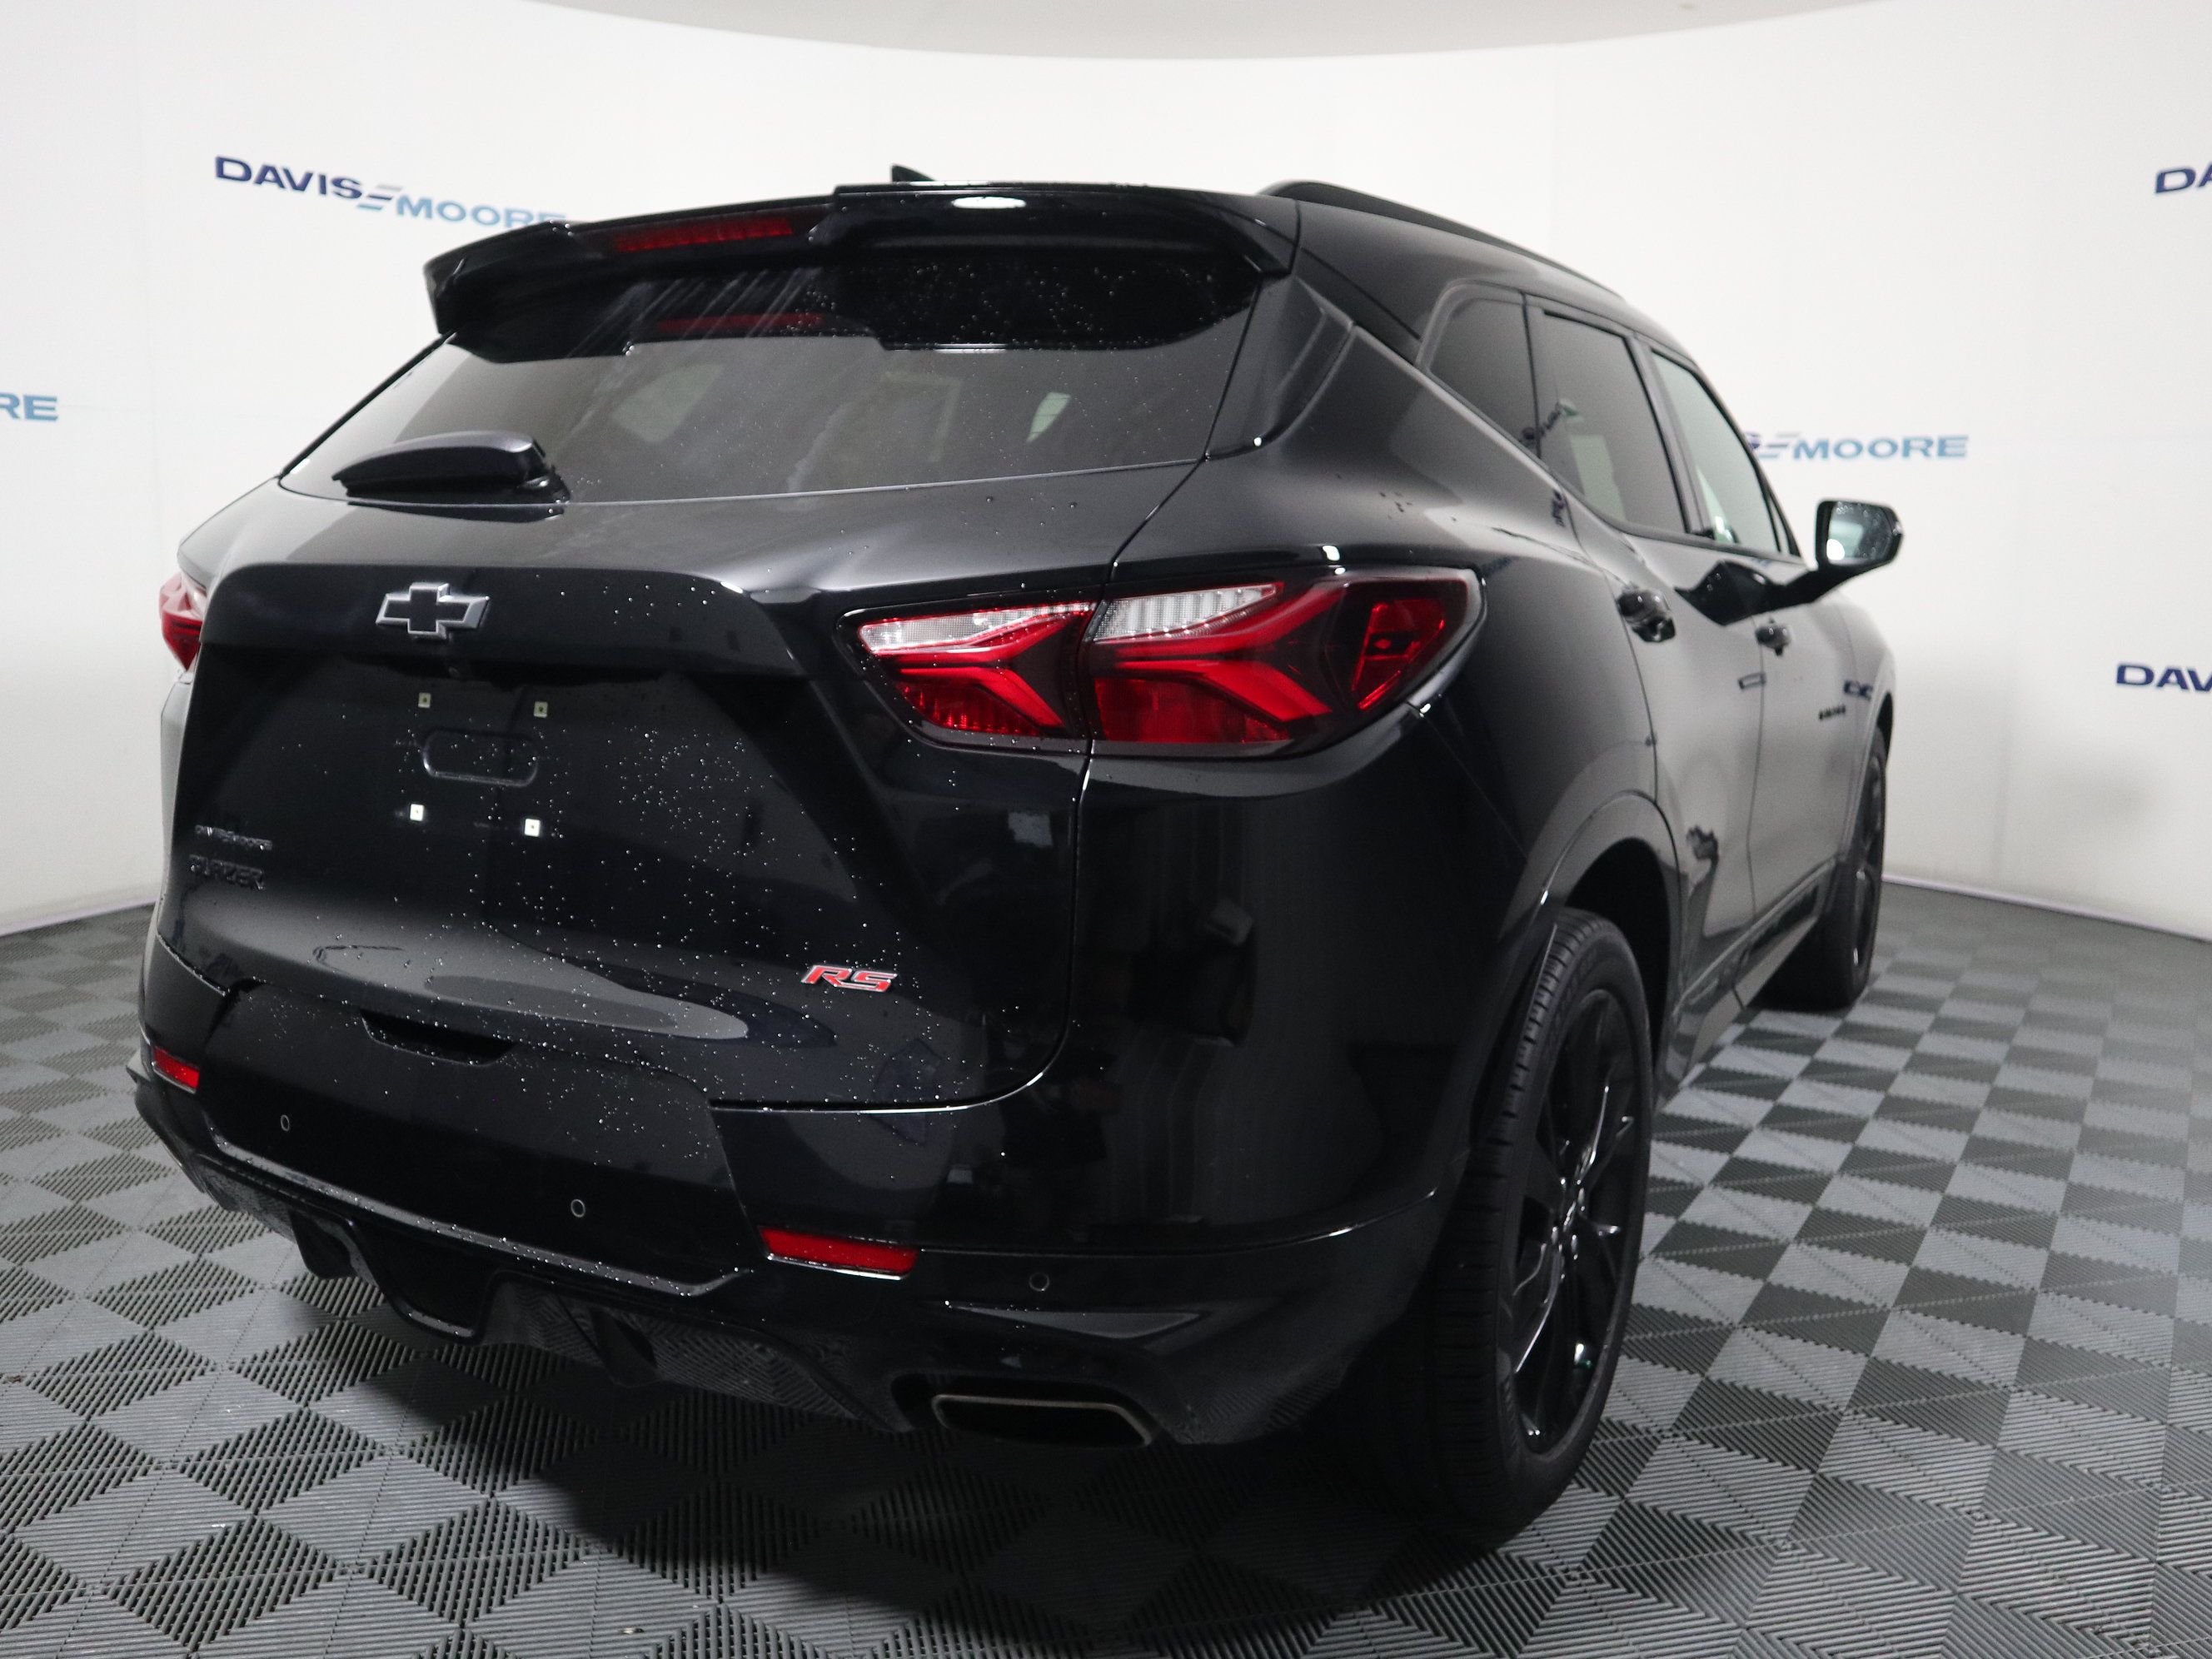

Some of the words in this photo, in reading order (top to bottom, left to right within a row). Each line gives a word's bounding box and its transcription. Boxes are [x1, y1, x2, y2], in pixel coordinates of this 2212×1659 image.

[215, 156, 363, 201] DAVIS
[1794, 435, 1969, 460] MOORE
[801, 964, 898, 992] RS
